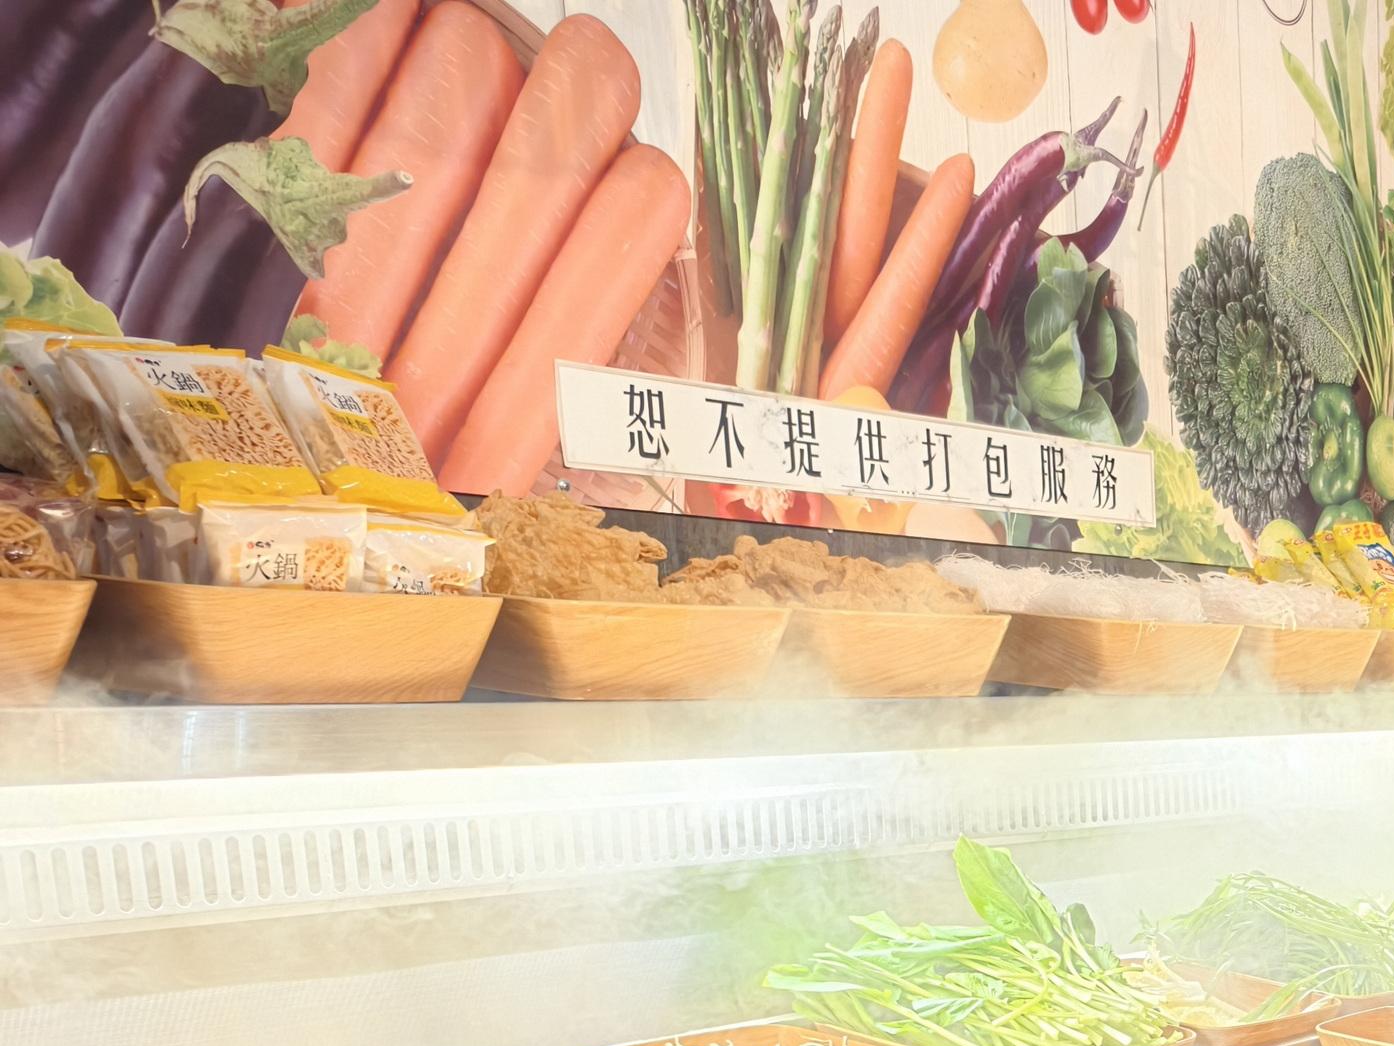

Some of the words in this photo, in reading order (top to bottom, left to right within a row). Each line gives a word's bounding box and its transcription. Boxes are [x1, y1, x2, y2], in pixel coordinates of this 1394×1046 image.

[147, 367, 205, 394] 火鍋
[316, 385, 363, 414] 火鍋
[623, 383, 1119, 510] 恕不提供打包服務
[245, 552, 299, 582] 火鍋
